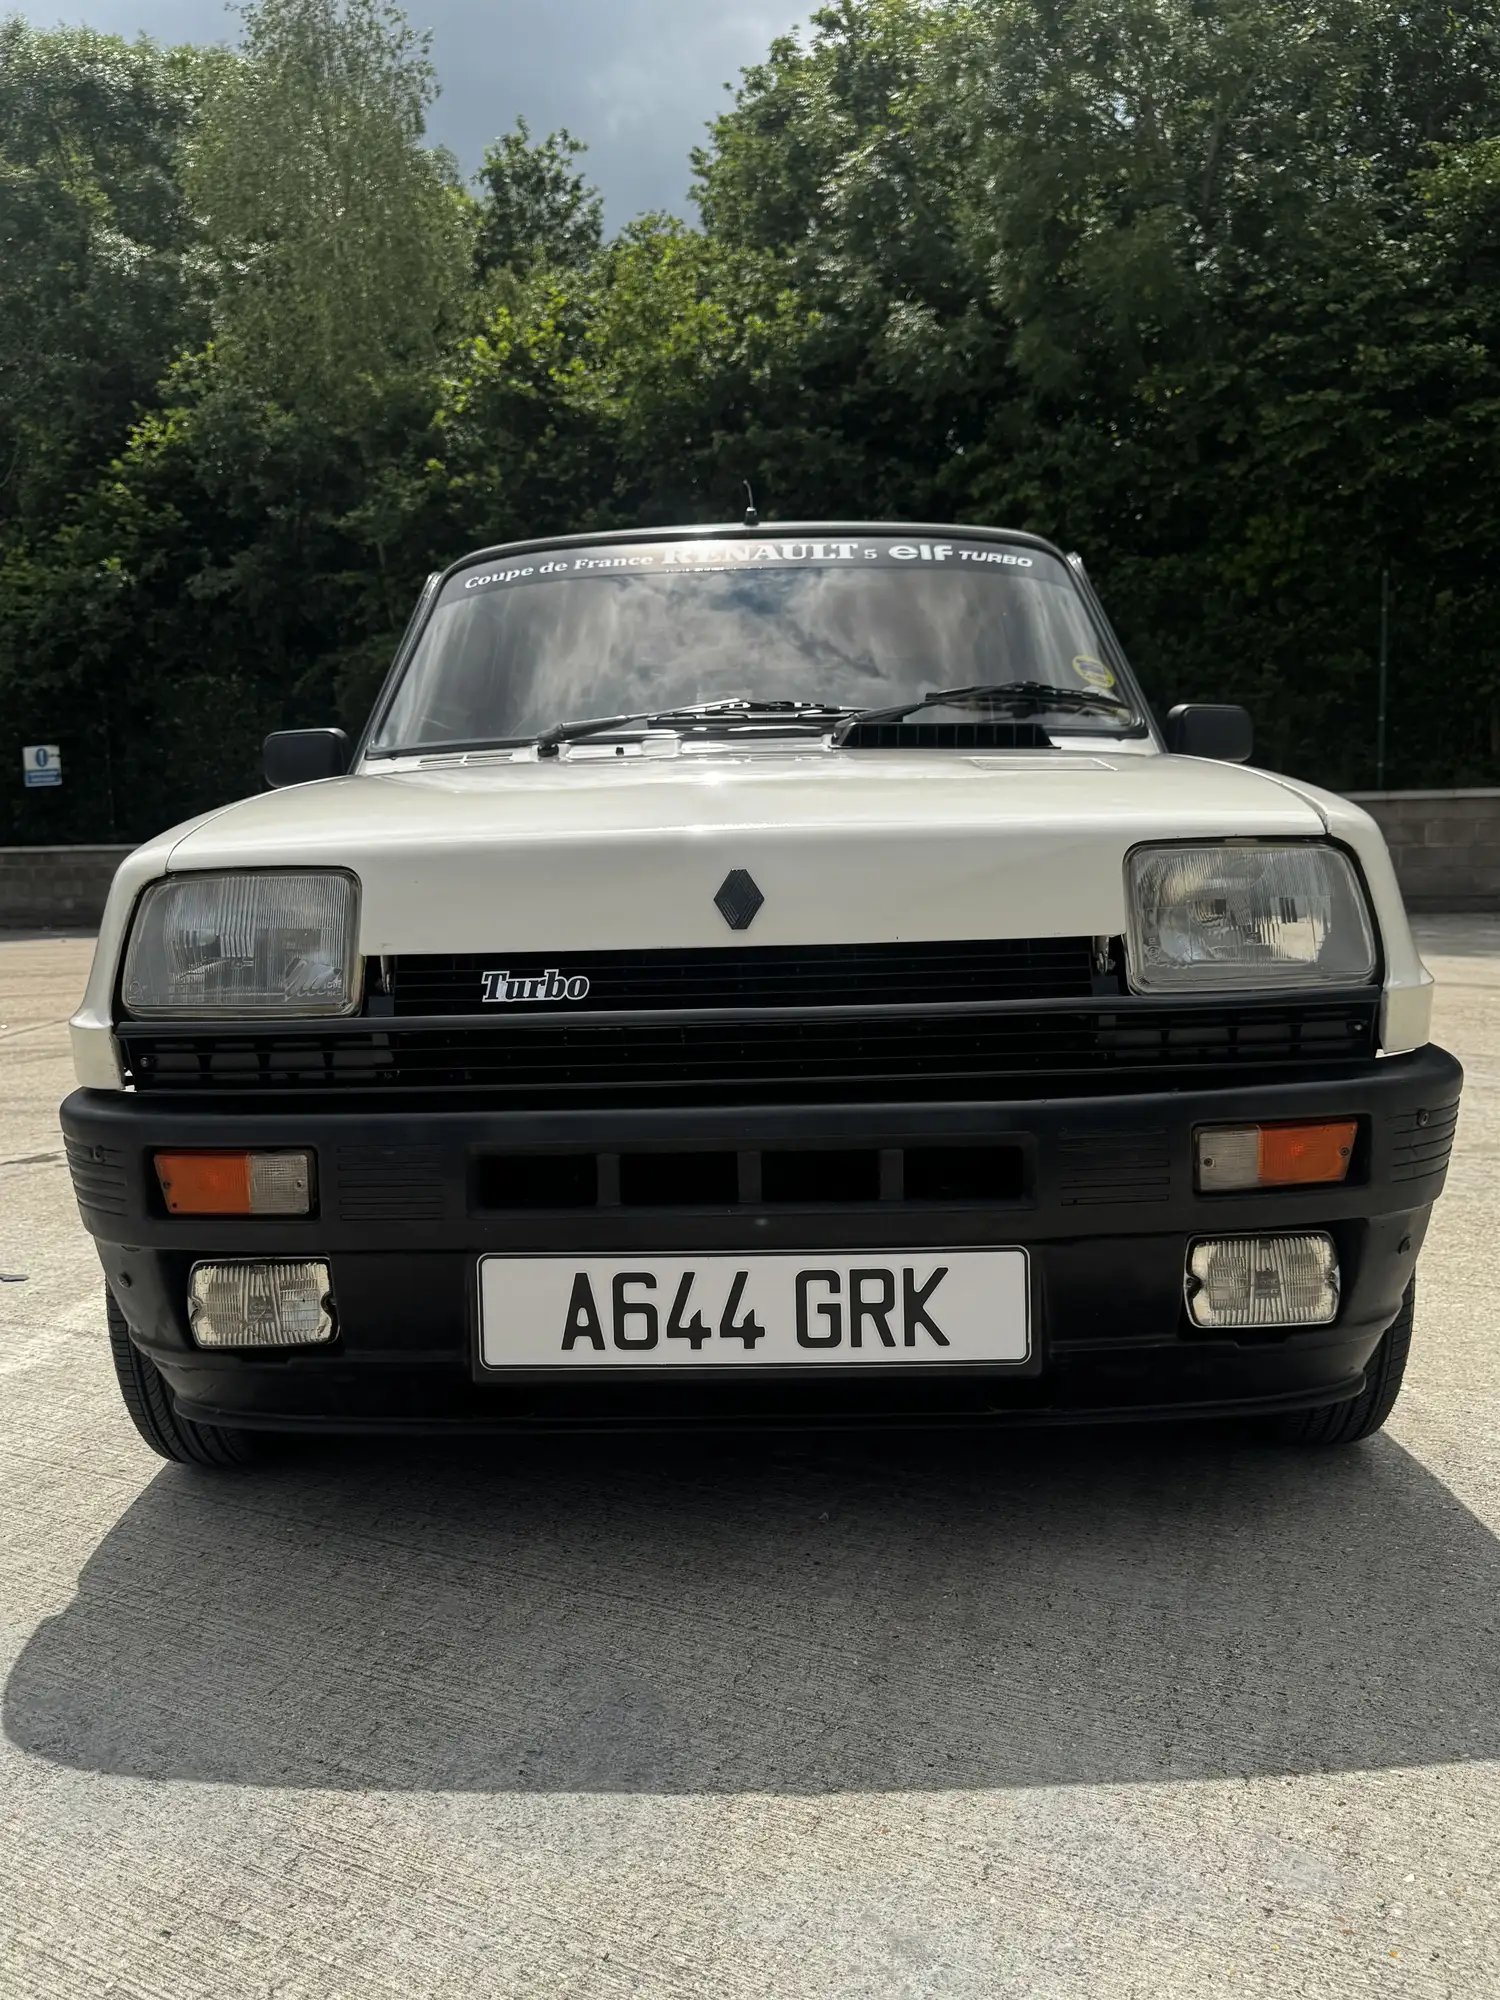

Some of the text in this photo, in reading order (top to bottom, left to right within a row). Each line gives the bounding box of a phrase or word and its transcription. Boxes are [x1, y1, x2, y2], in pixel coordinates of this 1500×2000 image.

[464, 543, 1033, 589] Coupe de France RENAULT 5 elf TURBO
[481, 969, 590, 1002] Turbo
[561, 1267, 951, 1351] A644 GRK
